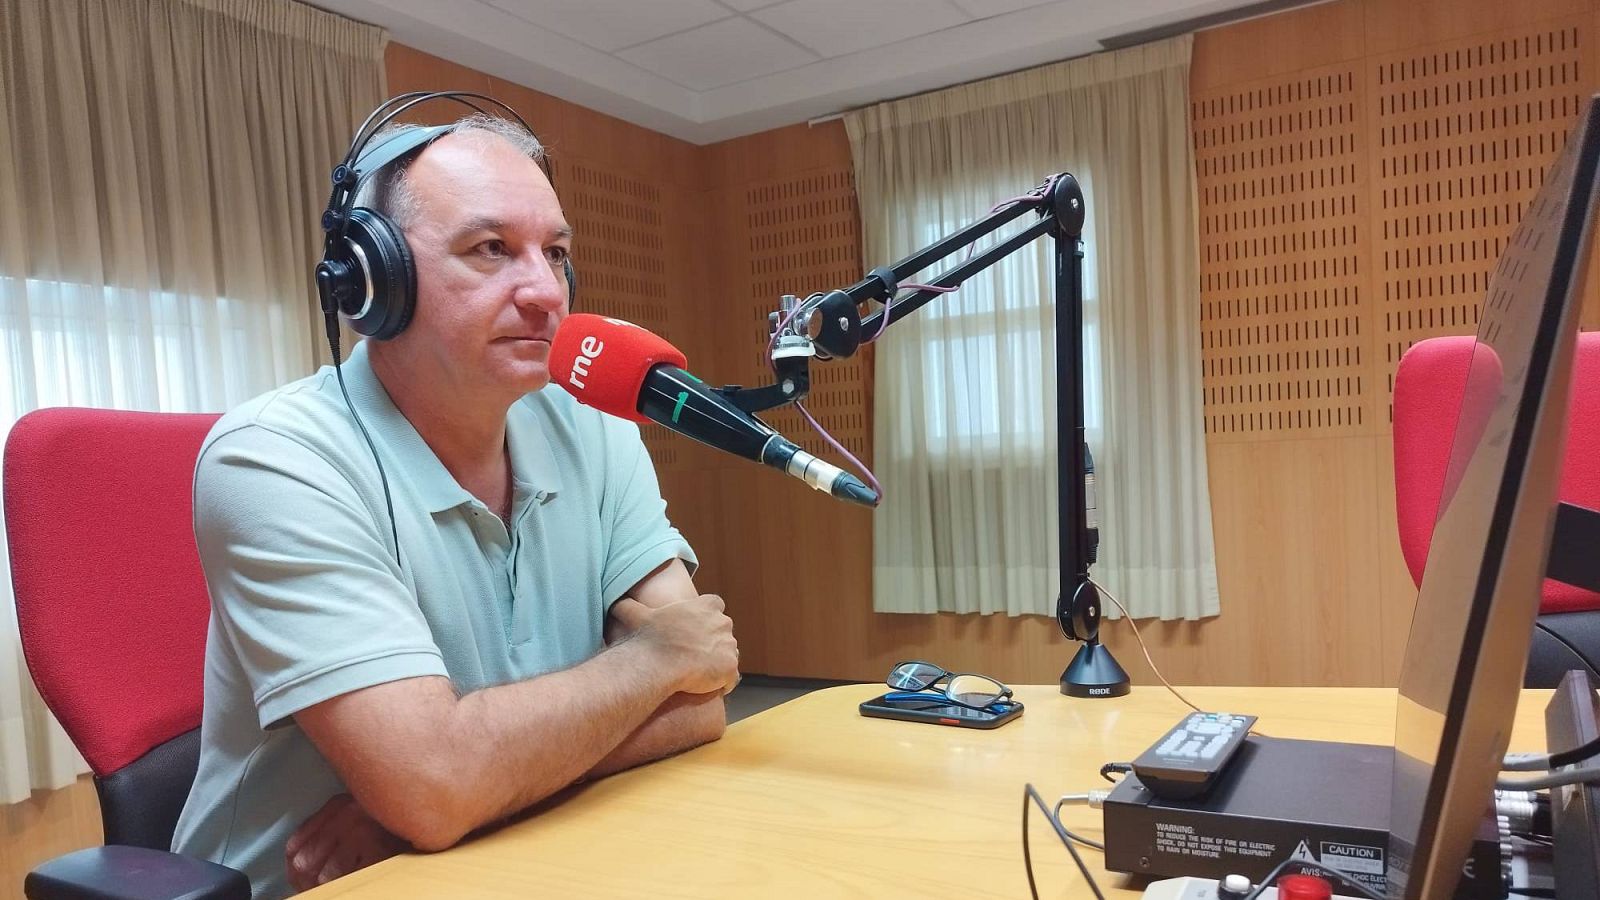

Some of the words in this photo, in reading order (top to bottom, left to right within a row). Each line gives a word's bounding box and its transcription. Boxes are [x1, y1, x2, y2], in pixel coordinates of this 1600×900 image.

[569, 336, 604, 390] rne
[671, 391, 689, 424] 1
[1155, 823, 1195, 834] WARNING:
[1165, 832, 1186, 841] REDUCE
[1188, 834, 1199, 842] THE
[1200, 836, 1214, 844] RISK
[1224, 839, 1237, 847] FIRE
[1250, 842, 1276, 851] ELECTRIC
[1187, 841, 1199, 849] NOT
[1200, 843, 1222, 852] EXPOSE
[1224, 846, 1237, 854] THIS
[1238, 847, 1272, 858] EQUIPMENT
[1328, 845, 1374, 858] CAUTION
